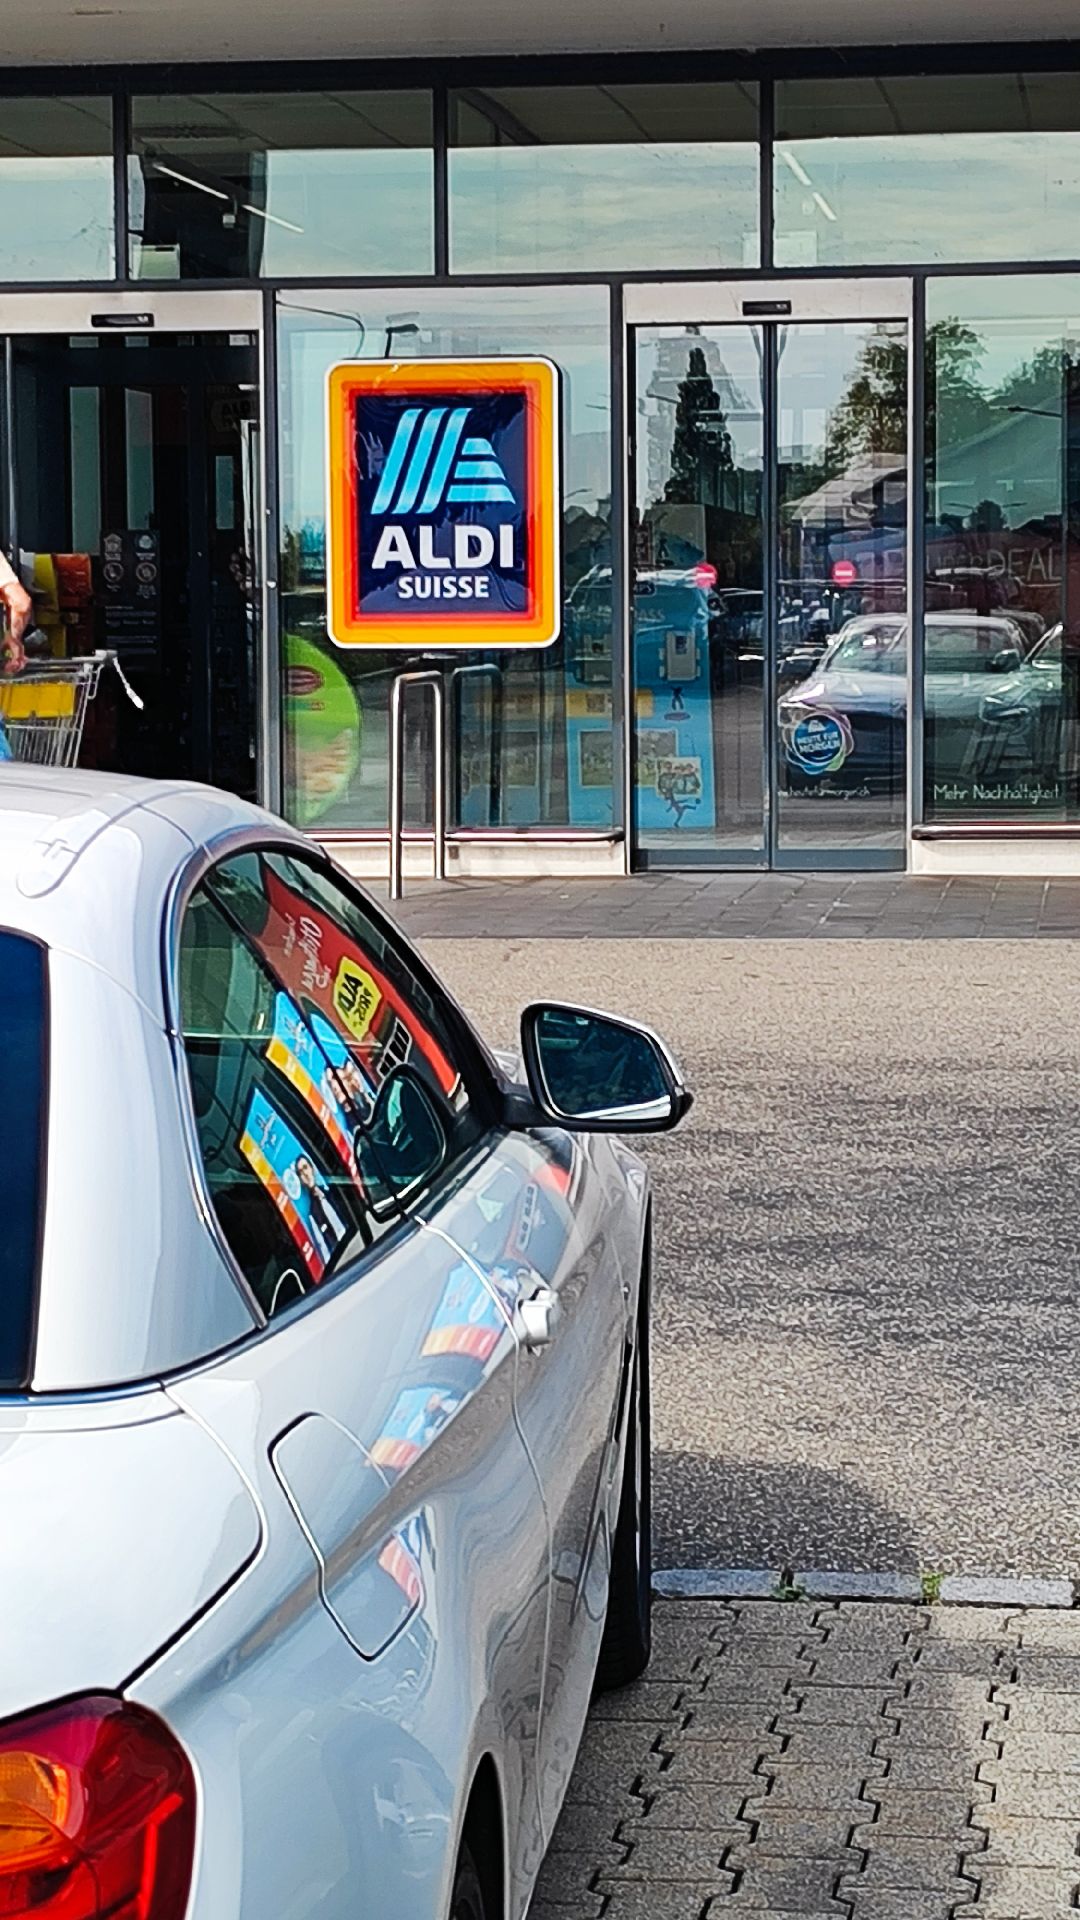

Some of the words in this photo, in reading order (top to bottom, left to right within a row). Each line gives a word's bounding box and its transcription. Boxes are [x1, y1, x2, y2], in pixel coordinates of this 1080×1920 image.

[371, 524, 514, 569] ALDI
[398, 575, 489, 598] SUISSE
[934, 783, 968, 800] Mehr
[973, 783, 1059, 805] Nachhaltigkeit
